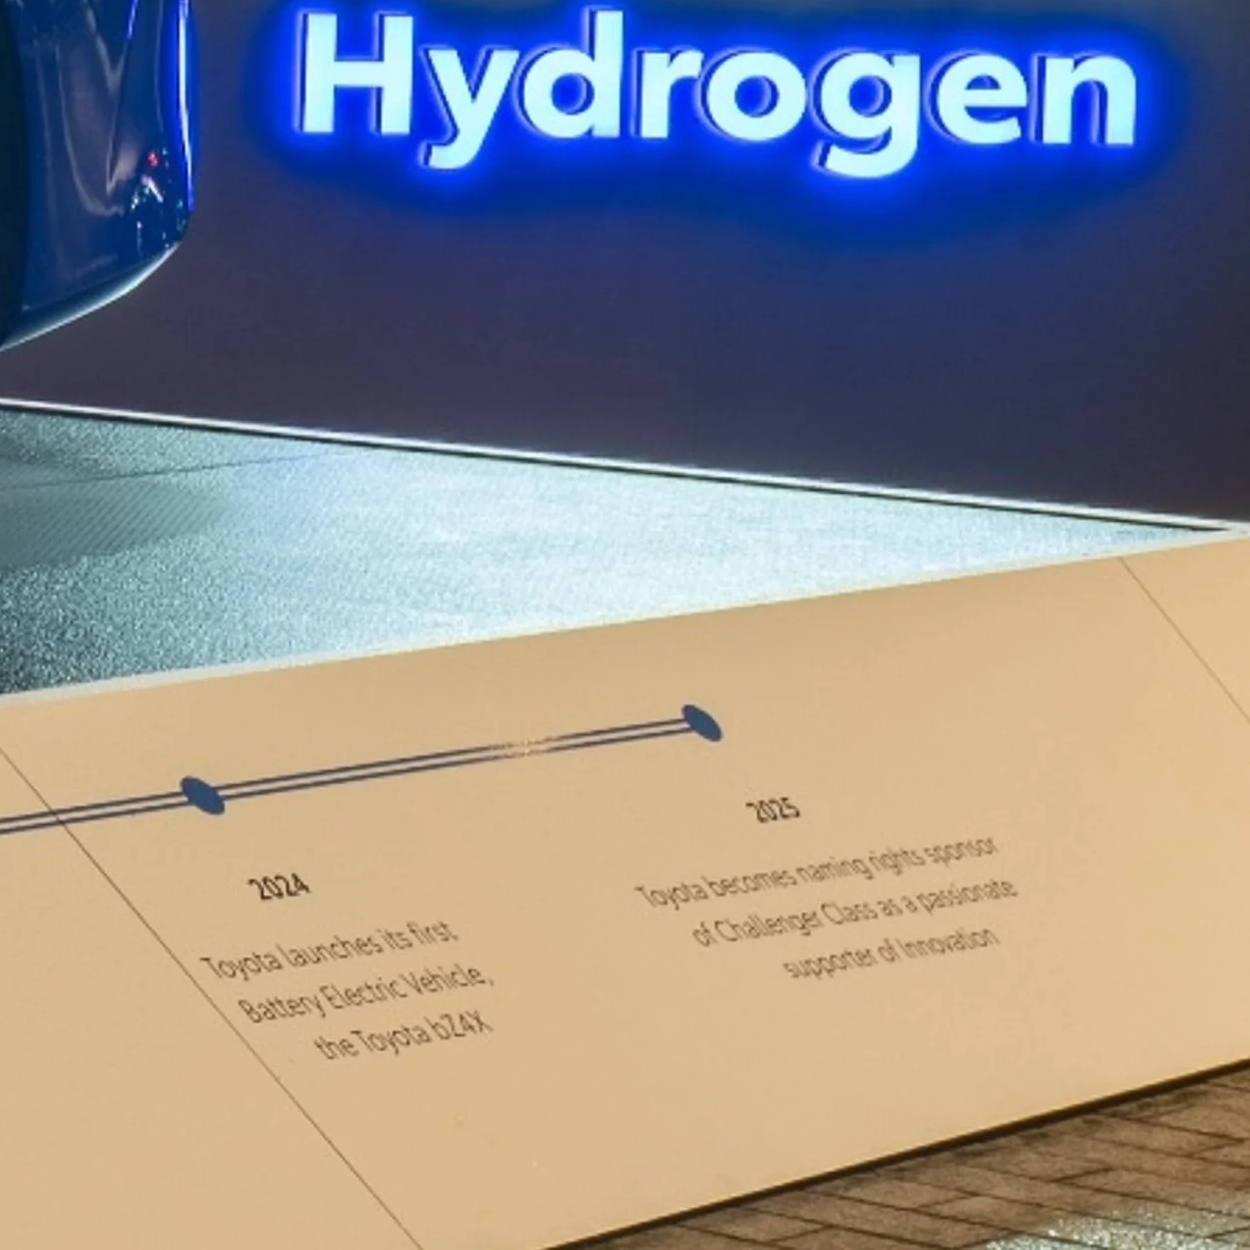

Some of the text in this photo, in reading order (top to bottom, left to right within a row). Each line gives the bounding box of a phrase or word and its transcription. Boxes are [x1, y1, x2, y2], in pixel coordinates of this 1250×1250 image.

[298, 7, 1138, 179] Hydrogen
[745, 796, 801, 824] 2025
[247, 872, 312, 900] 2024
[635, 836, 999, 911] Toyota becomes naming rights sponsor
[692, 880, 1018, 947] of Challenger Class as a passionate
[199, 919, 460, 982] Toyota launches its first
[783, 928, 1000, 981] supporter of Innovation
[237, 963, 495, 1024] Battery Electric Vehicle,
[314, 1009, 494, 1061] the Toyota bZ4X
